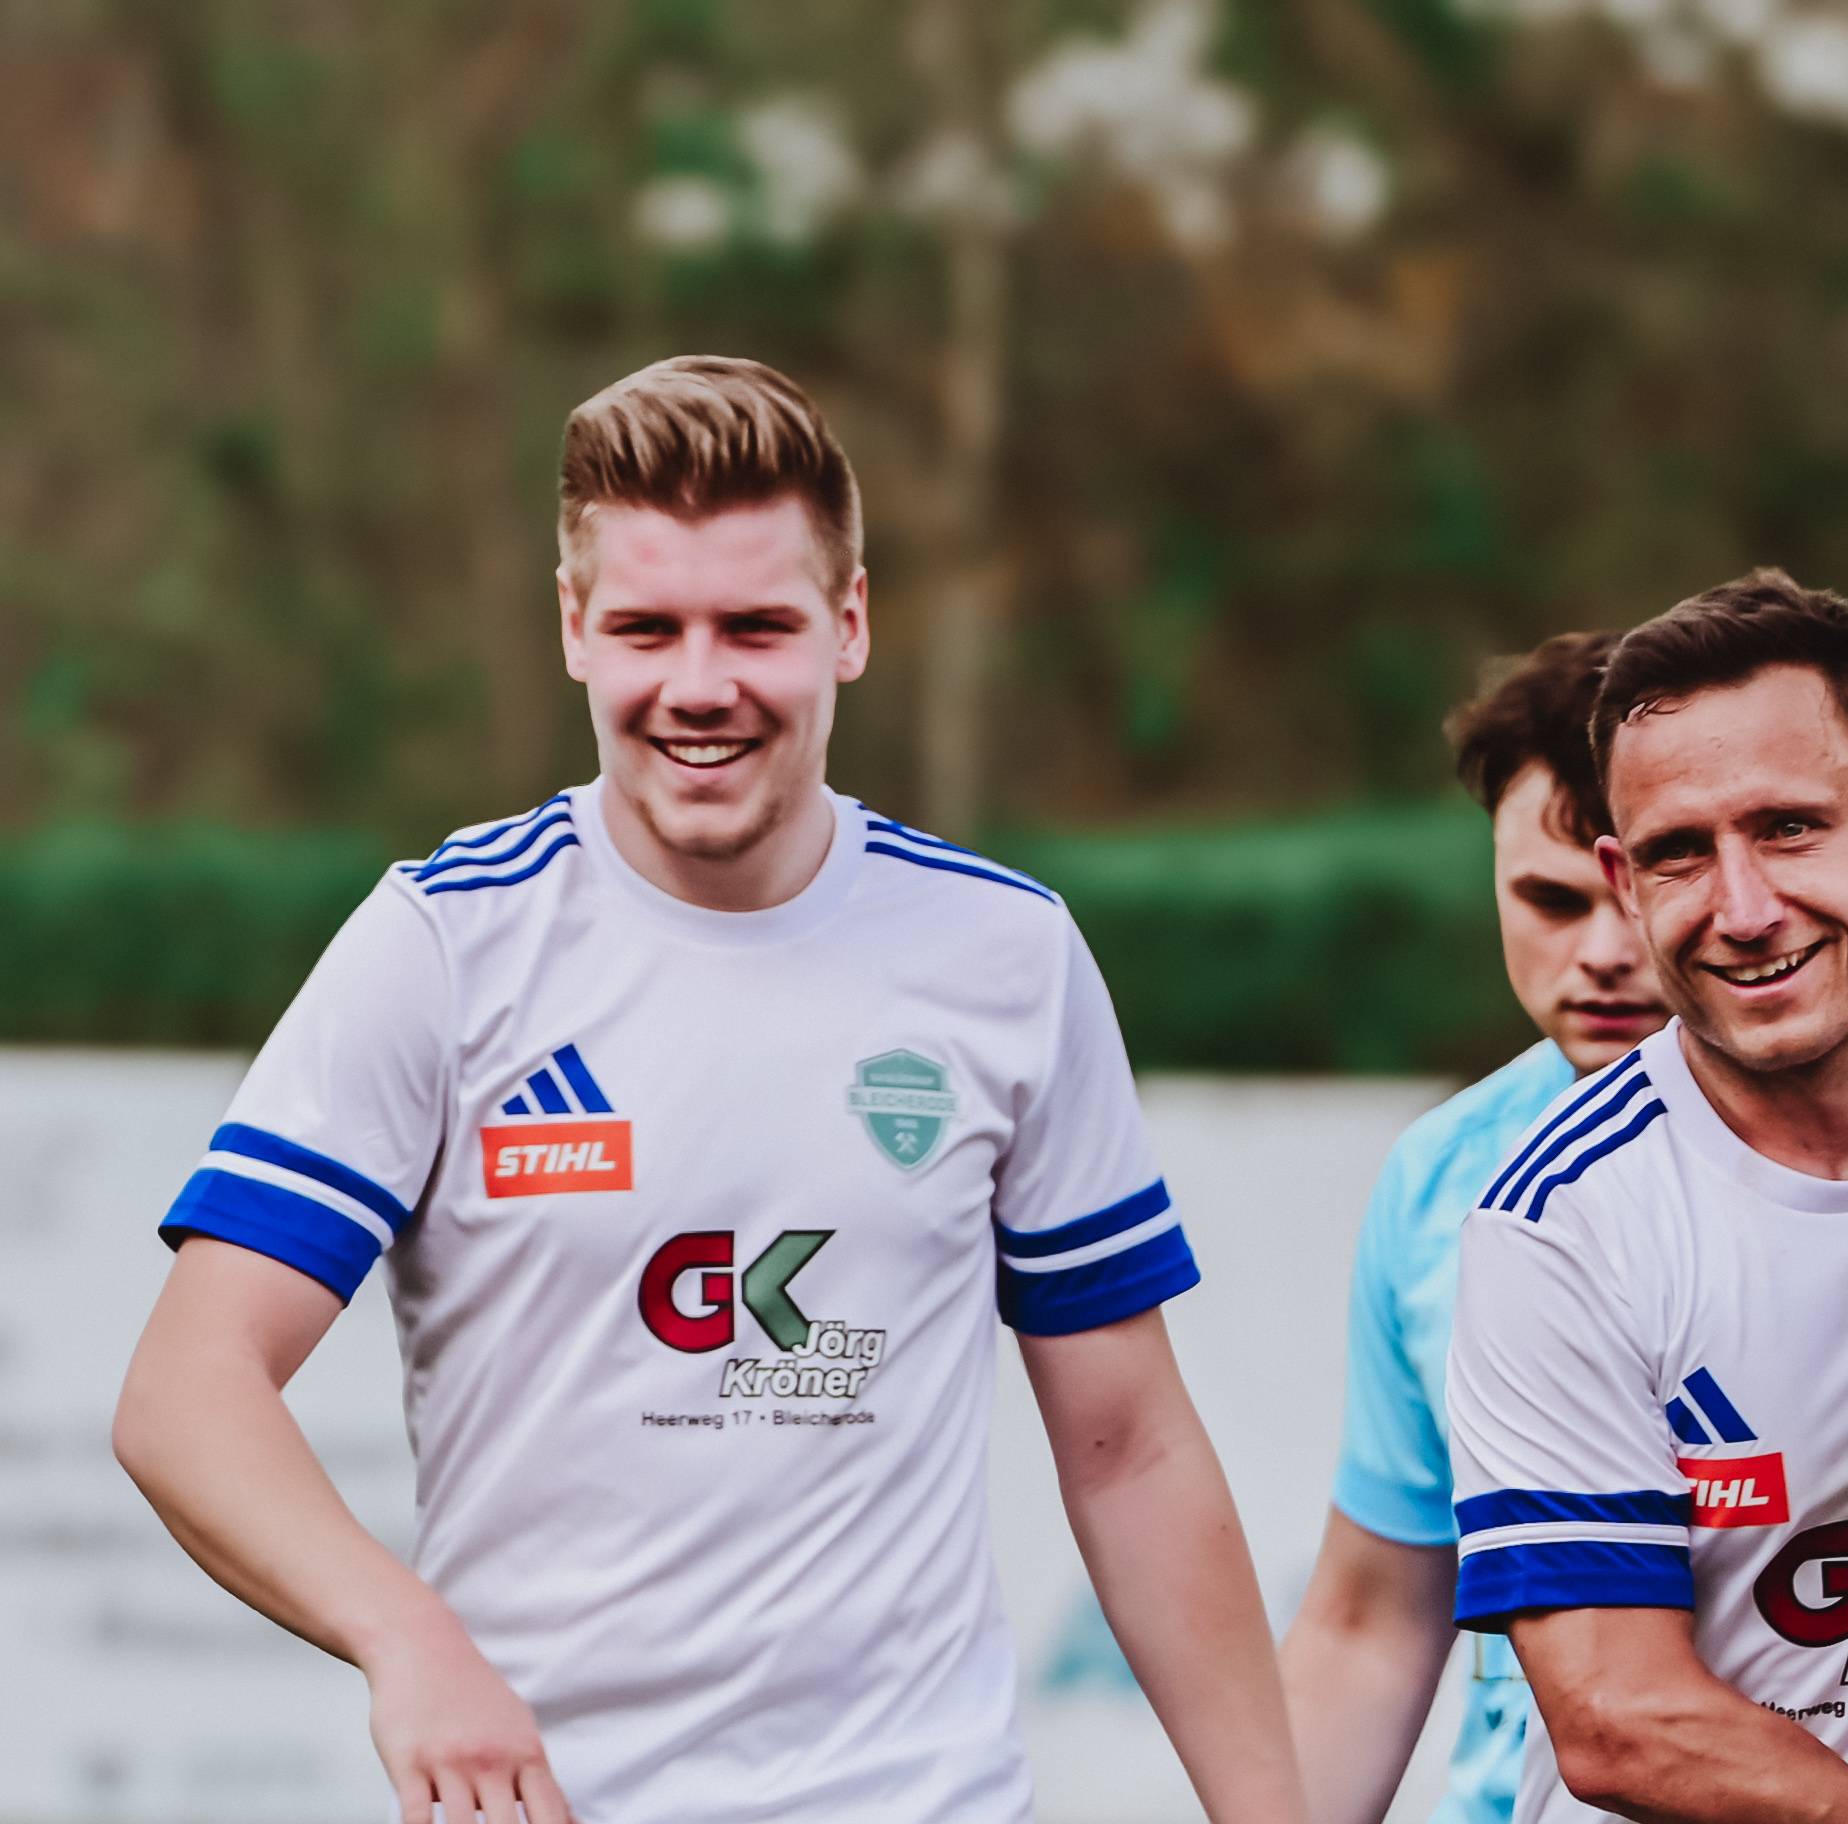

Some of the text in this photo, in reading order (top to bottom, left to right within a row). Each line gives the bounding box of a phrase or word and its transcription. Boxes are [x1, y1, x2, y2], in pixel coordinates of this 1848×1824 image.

[495, 1141, 616, 1178] STIHL
[792, 1320, 886, 1368] Jörg
[719, 1358, 868, 1398] Kröner
[642, 1410, 875, 1429] Heerweg 17 Bleicherode
